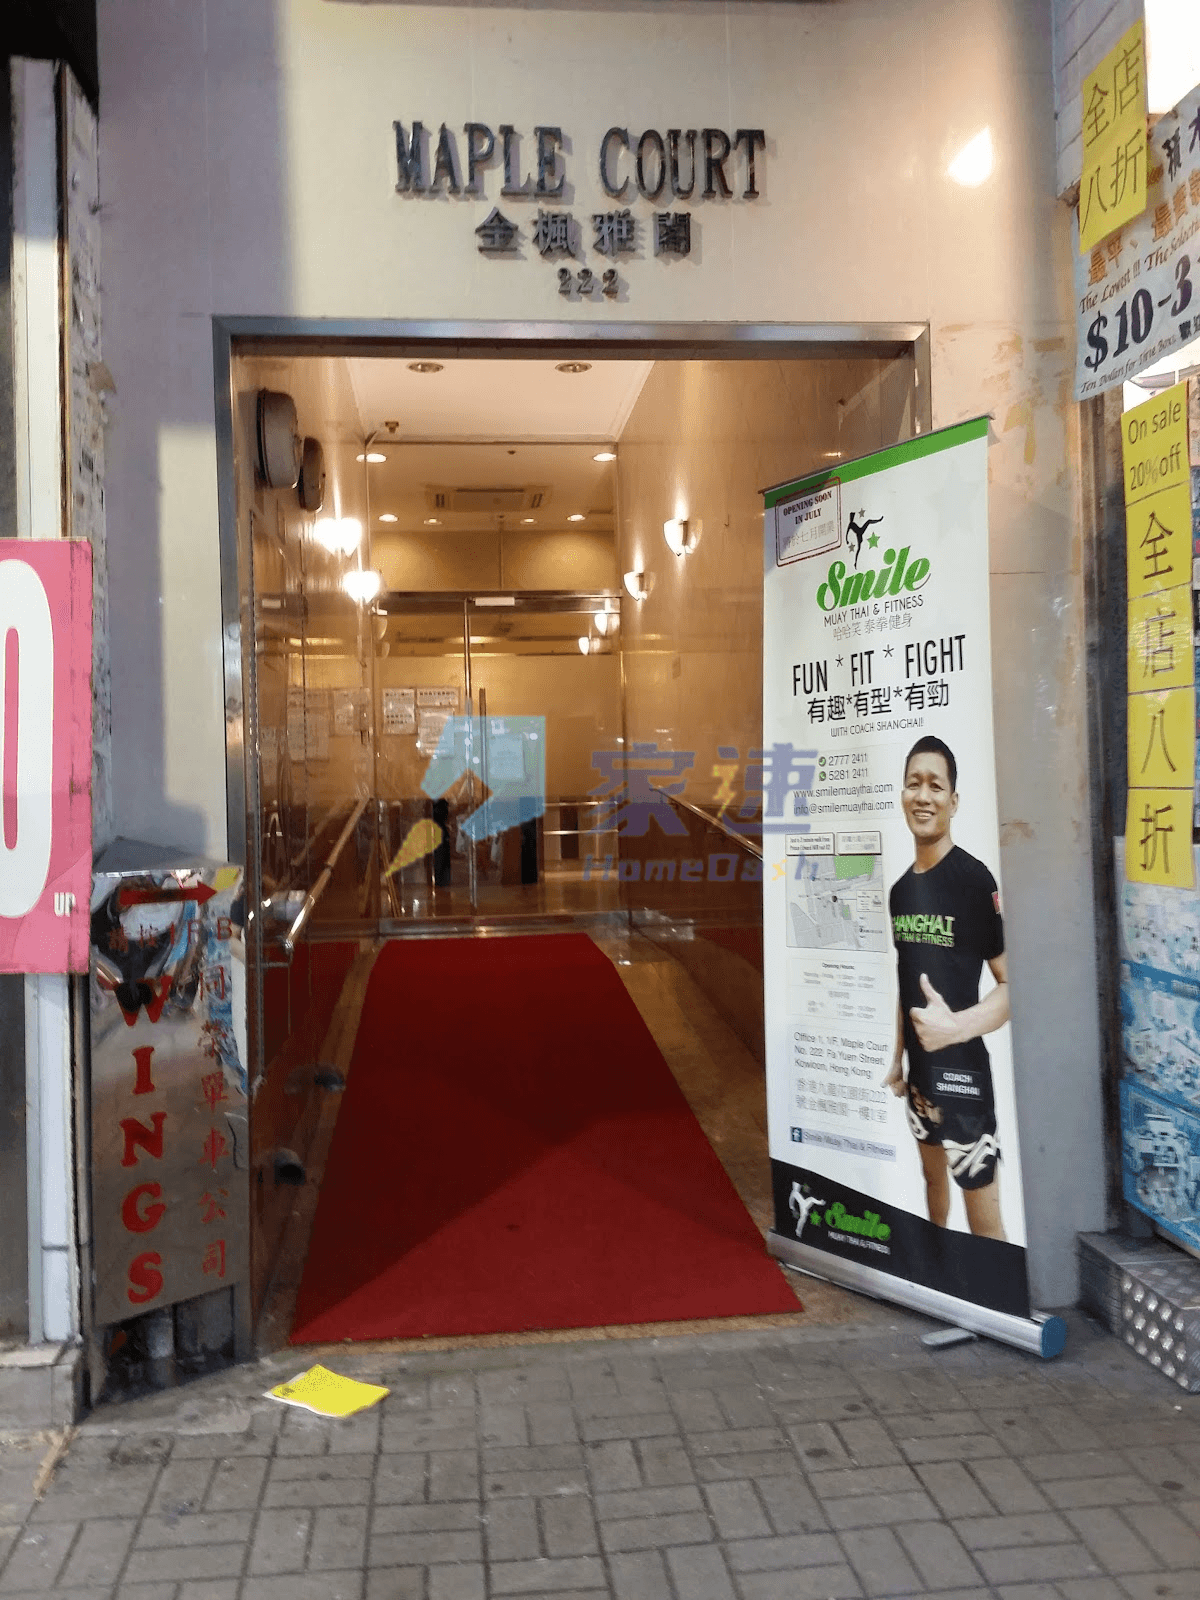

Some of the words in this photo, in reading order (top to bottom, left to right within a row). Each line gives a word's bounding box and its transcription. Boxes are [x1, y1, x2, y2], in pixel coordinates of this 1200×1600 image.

[1083, 38, 1142, 148] 全店
[392, 120, 565, 197] MAPLE
[600, 126, 766, 199] COURT
[1081, 128, 1143, 234] 八折
[475, 205, 691, 258] 金楓雅閣
[557, 267, 620, 296] 222
[1079, 291, 1098, 314] The
[1144, 246, 1168, 271] The
[1128, 419, 1147, 446] On
[1152, 400, 1181, 435] sale
[783, 498, 814, 517] OPENING
[814, 490, 832, 505] SOON
[795, 515, 804, 525] IN
[804, 507, 822, 521] JULY
[816, 545, 931, 612] Smile
[824, 611, 847, 628] MUAY
[850, 605, 869, 620] THAI
[872, 603, 880, 615] &
[884, 594, 924, 614] FITNESS
[793, 660, 828, 697] FUN
[850, 649, 875, 687] FIT
[904, 634, 966, 679] FIGHT
[830, 727, 848, 738] WITH
[849, 722, 875, 736] COACH
[828, 754, 850, 767] 2777
[851, 752, 868, 764] 2411
[828, 769, 849, 781] 5281
[852, 767, 868, 779] 2411
[793, 783, 894, 798] www.smilemuaythai.com
[794, 800, 895, 815] info@smilemuaythai.com
[838, 1050, 857, 1061] Yuen
[840, 1037, 864, 1049] Maple
[866, 1041, 888, 1052] Court
[830, 1062, 849, 1077] Hong
[851, 1066, 871, 1080] Kong
[942, 1072, 973, 1084] COACH
[936, 1082, 980, 1096] SHANGHAI
[112, 975, 173, 1304] WINGS
